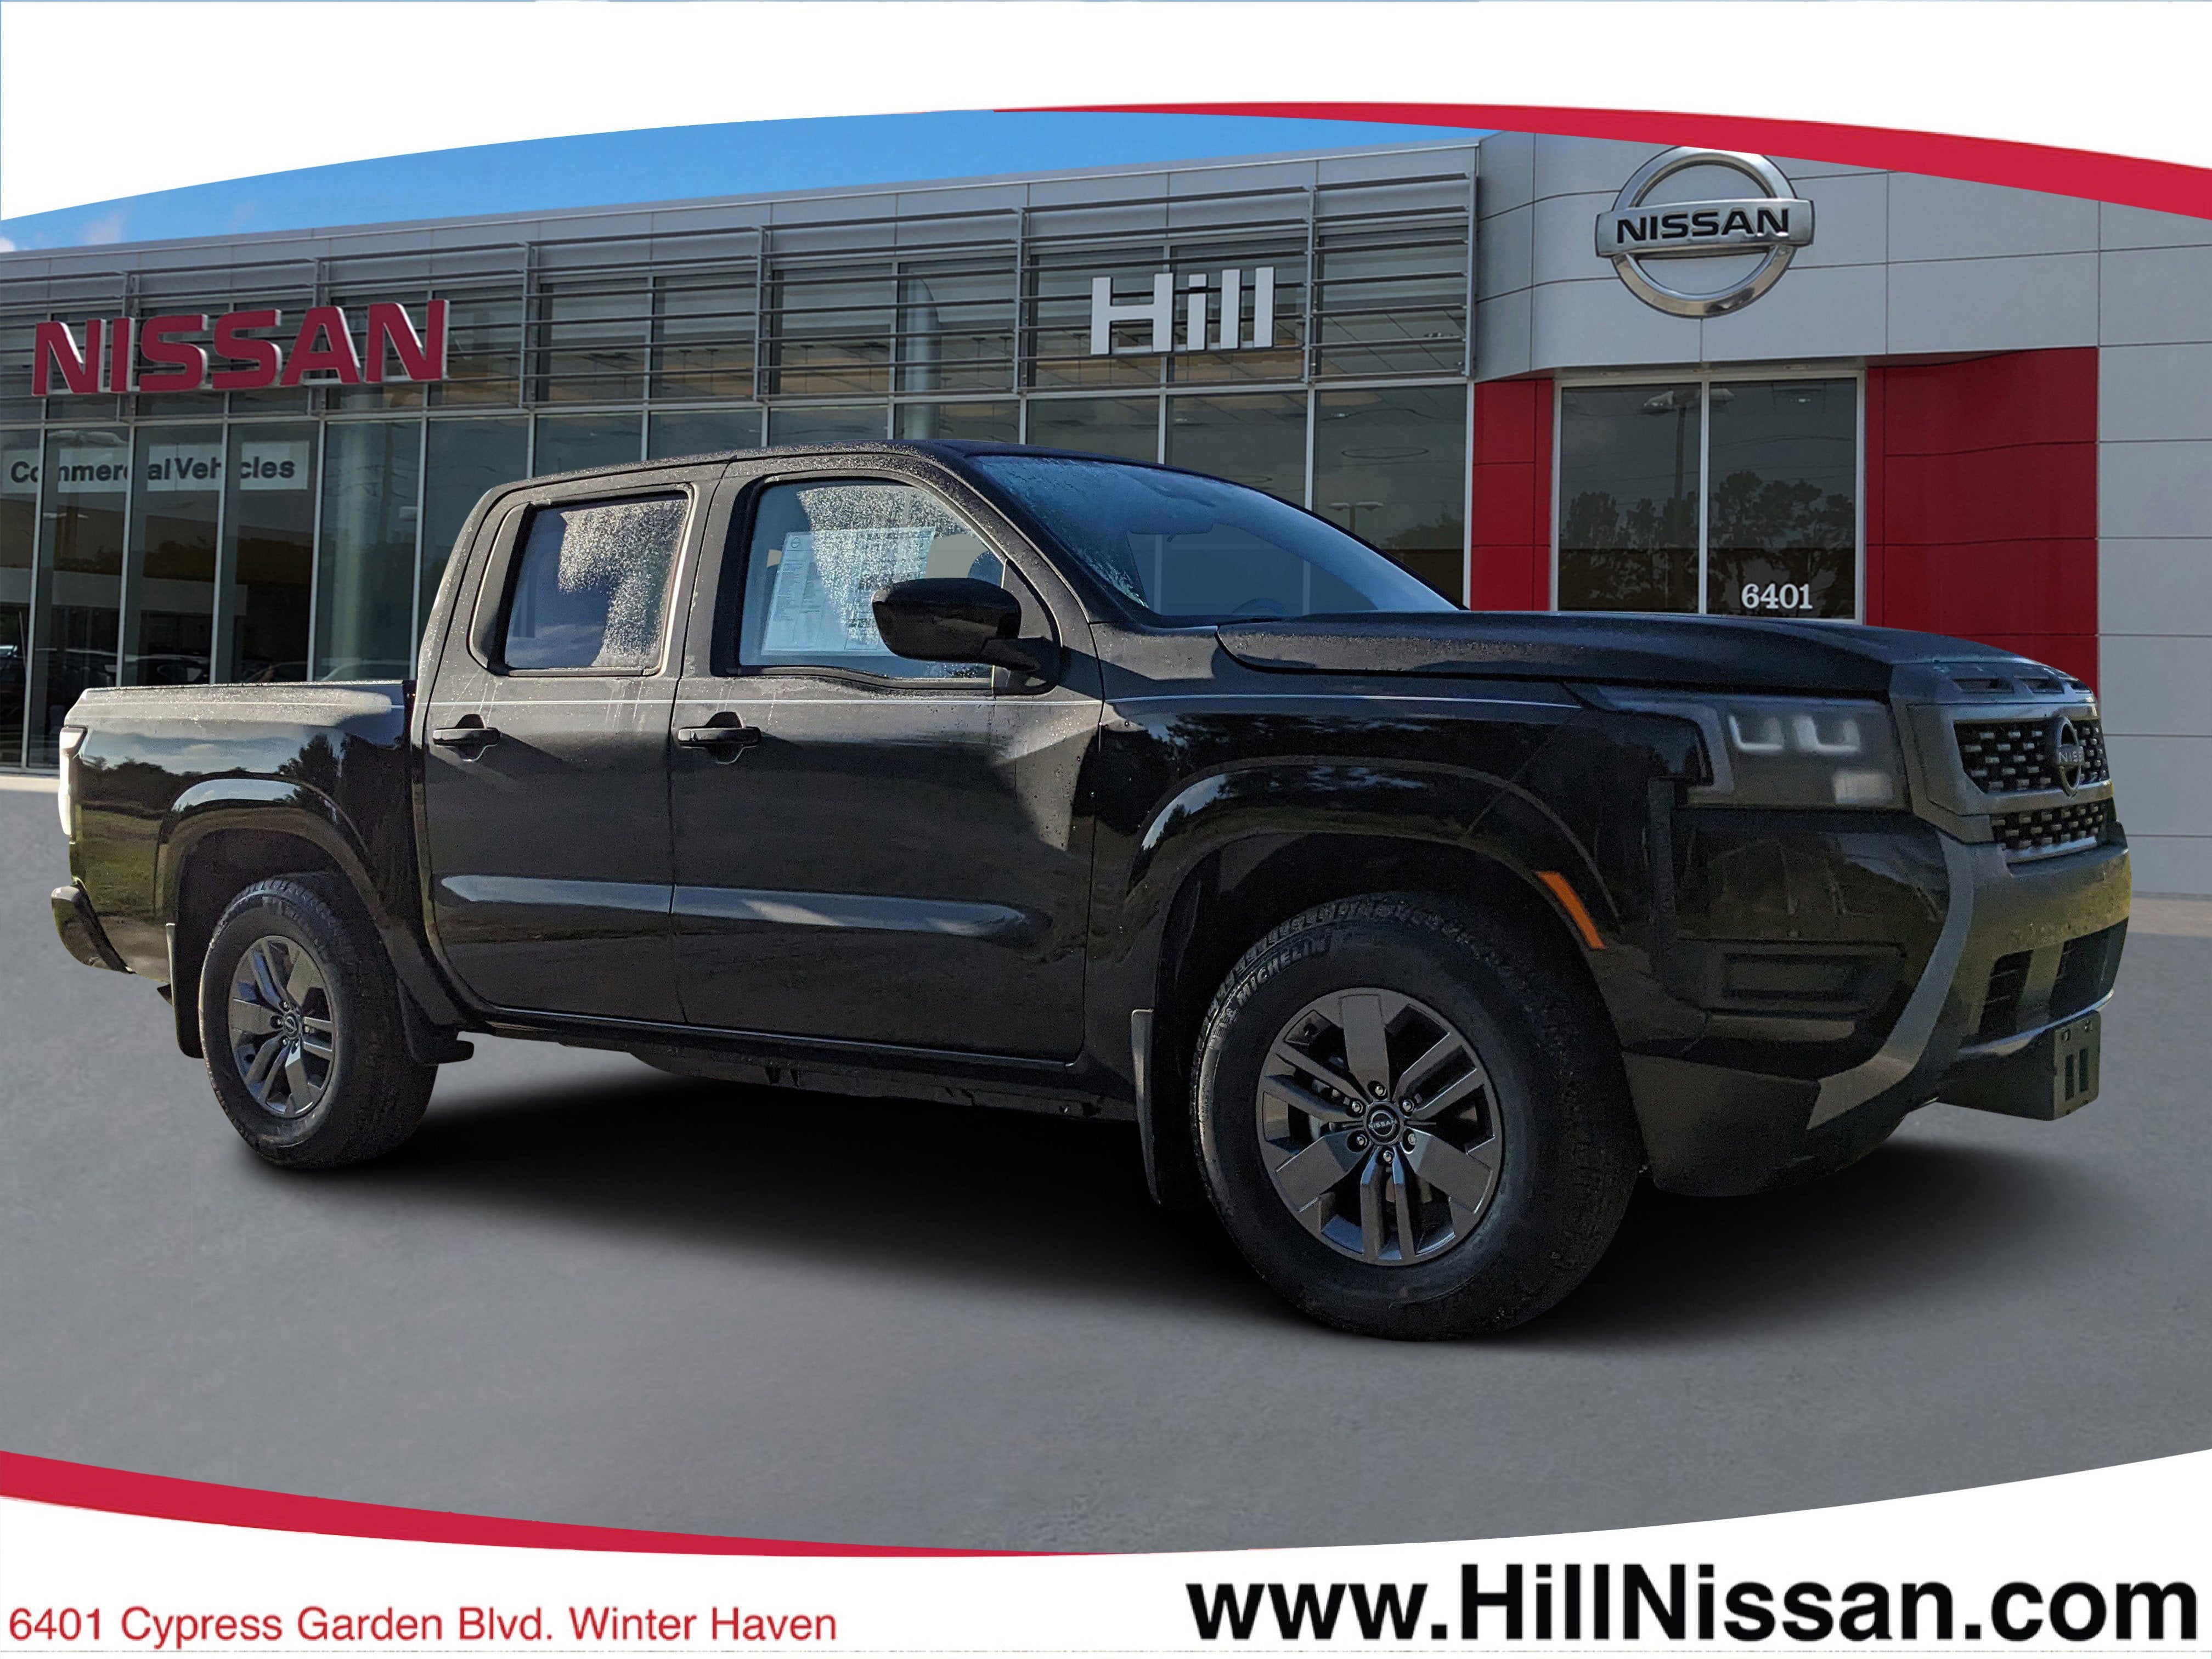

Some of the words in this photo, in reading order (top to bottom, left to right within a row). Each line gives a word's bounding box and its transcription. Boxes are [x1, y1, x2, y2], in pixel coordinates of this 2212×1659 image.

[1617, 207, 1790, 244] NISSAN
[1090, 267, 1274, 355] Hill
[31, 300, 449, 396] NISSAN
[10, 458, 171, 483] Commeral
[174, 455, 295, 479] Vehcles
[1741, 583, 1813, 610] 6401
[1237, 938, 1327, 1006] MICHELIN
[1368, 1119, 1398, 1130] NISSAN
